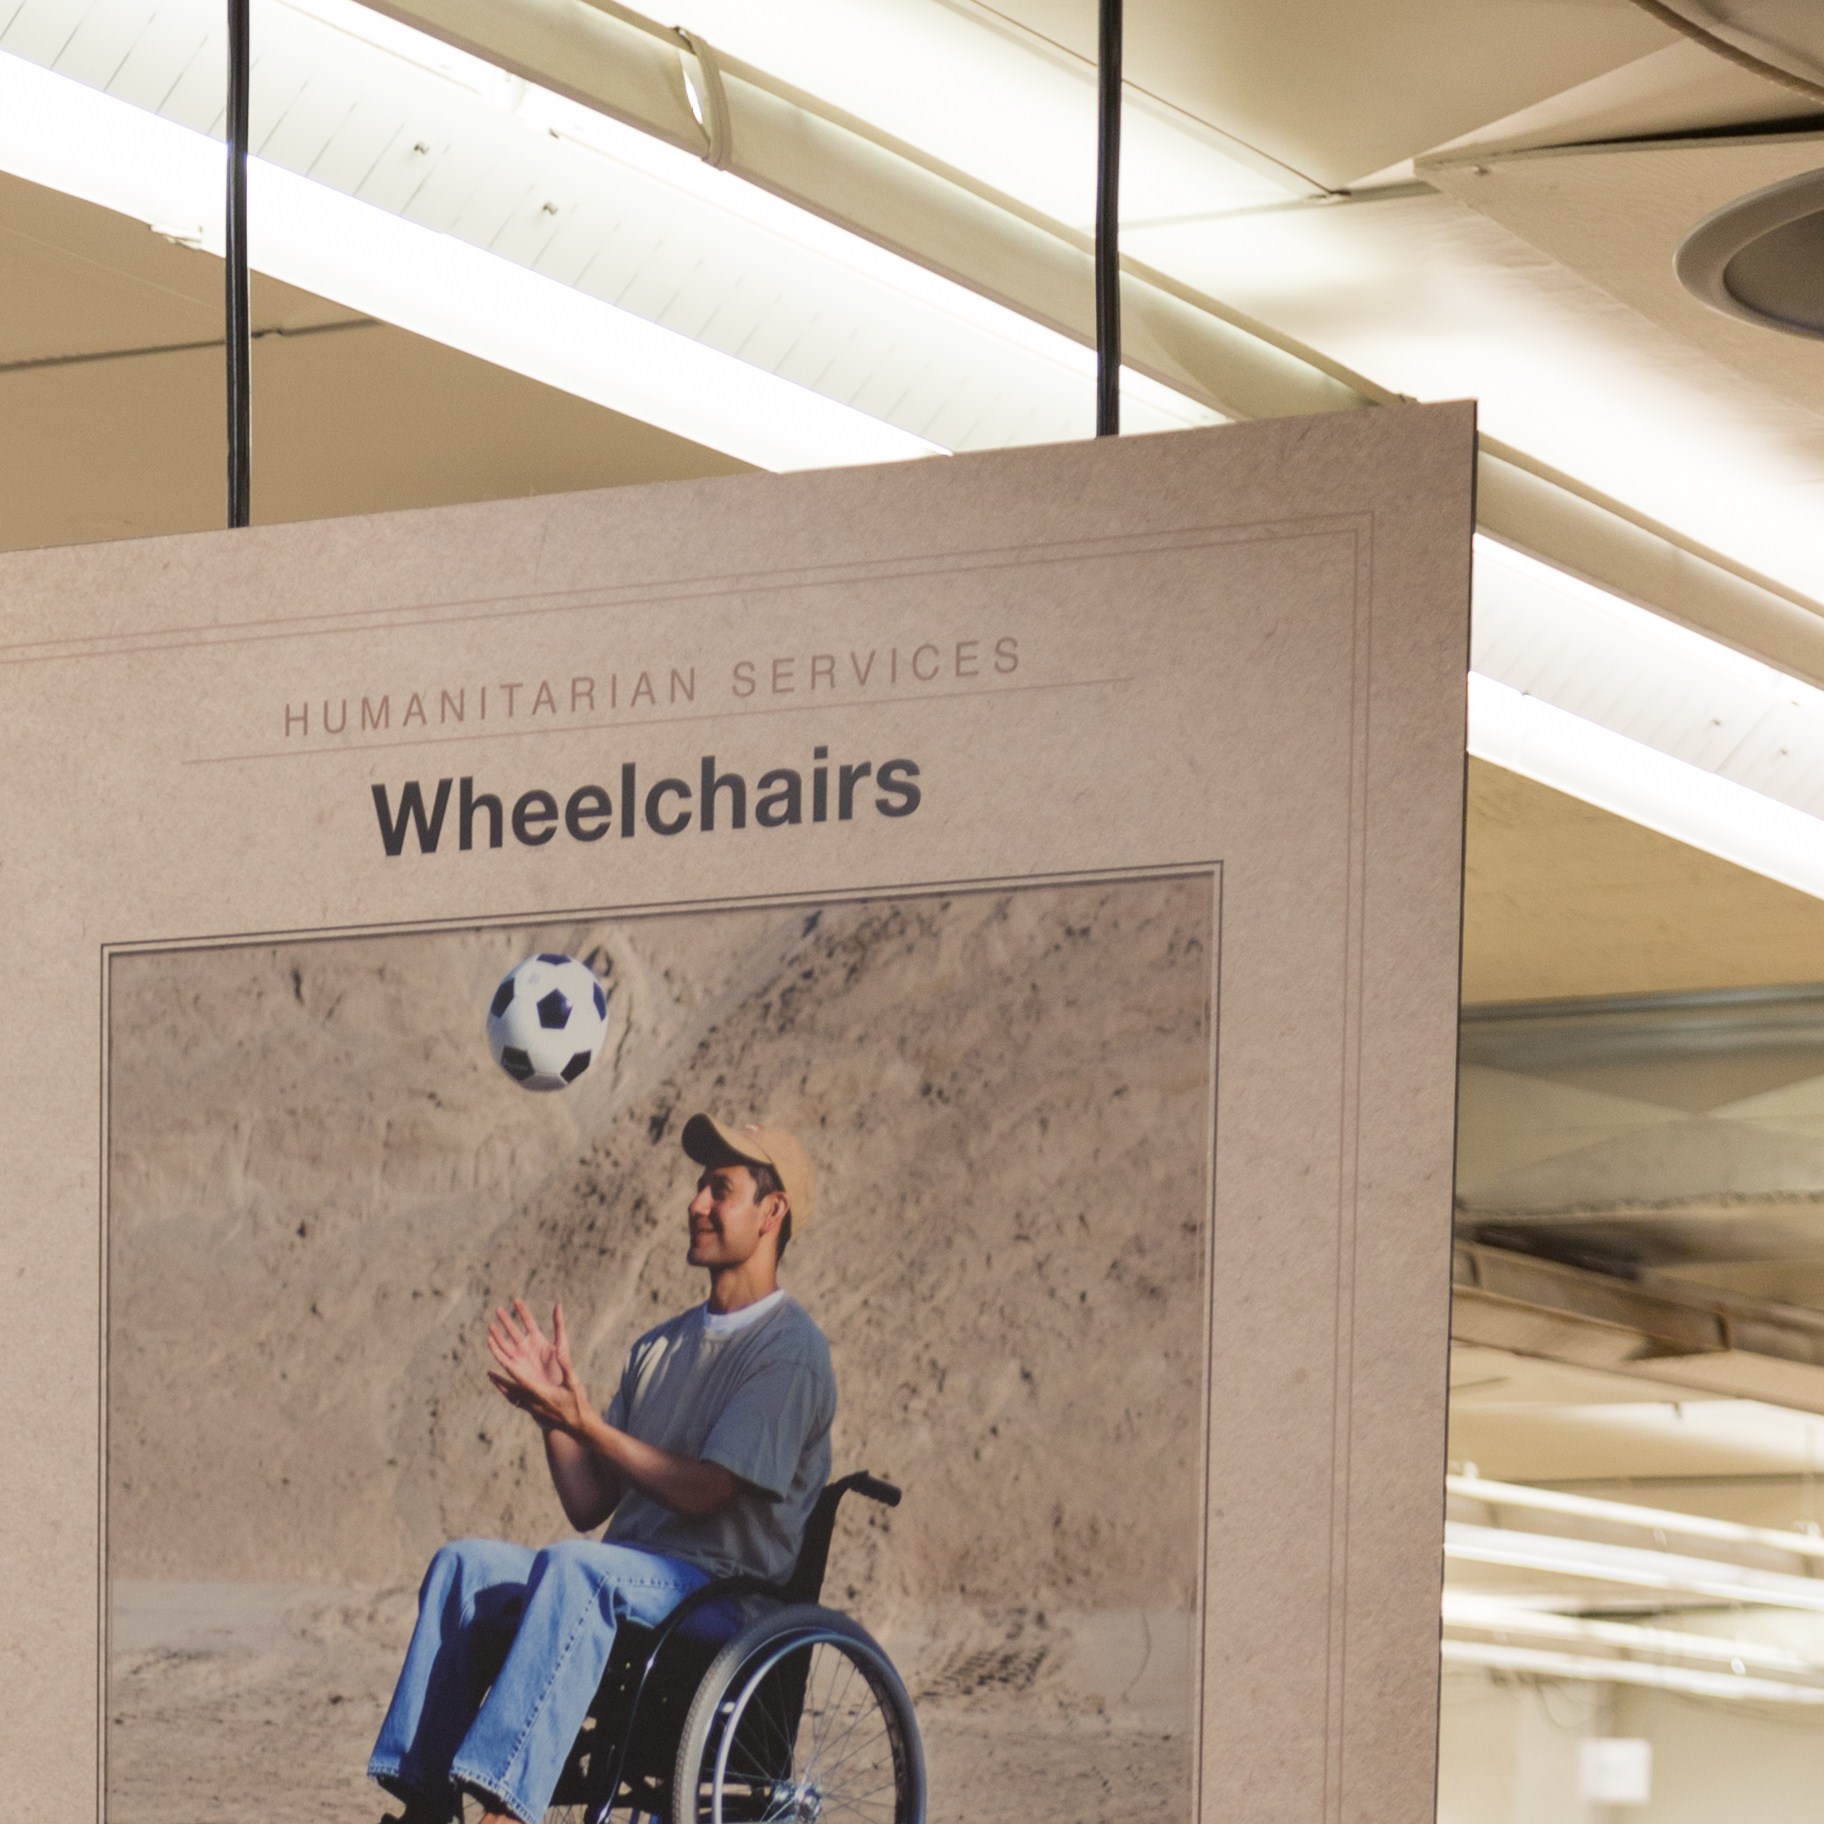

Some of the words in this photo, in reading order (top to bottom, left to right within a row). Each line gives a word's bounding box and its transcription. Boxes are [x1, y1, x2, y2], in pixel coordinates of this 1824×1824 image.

[283, 667, 697, 738] HUMANITARIAN
[731, 636, 1021, 698] SERVICES
[370, 745, 923, 857] Wheelchairs
